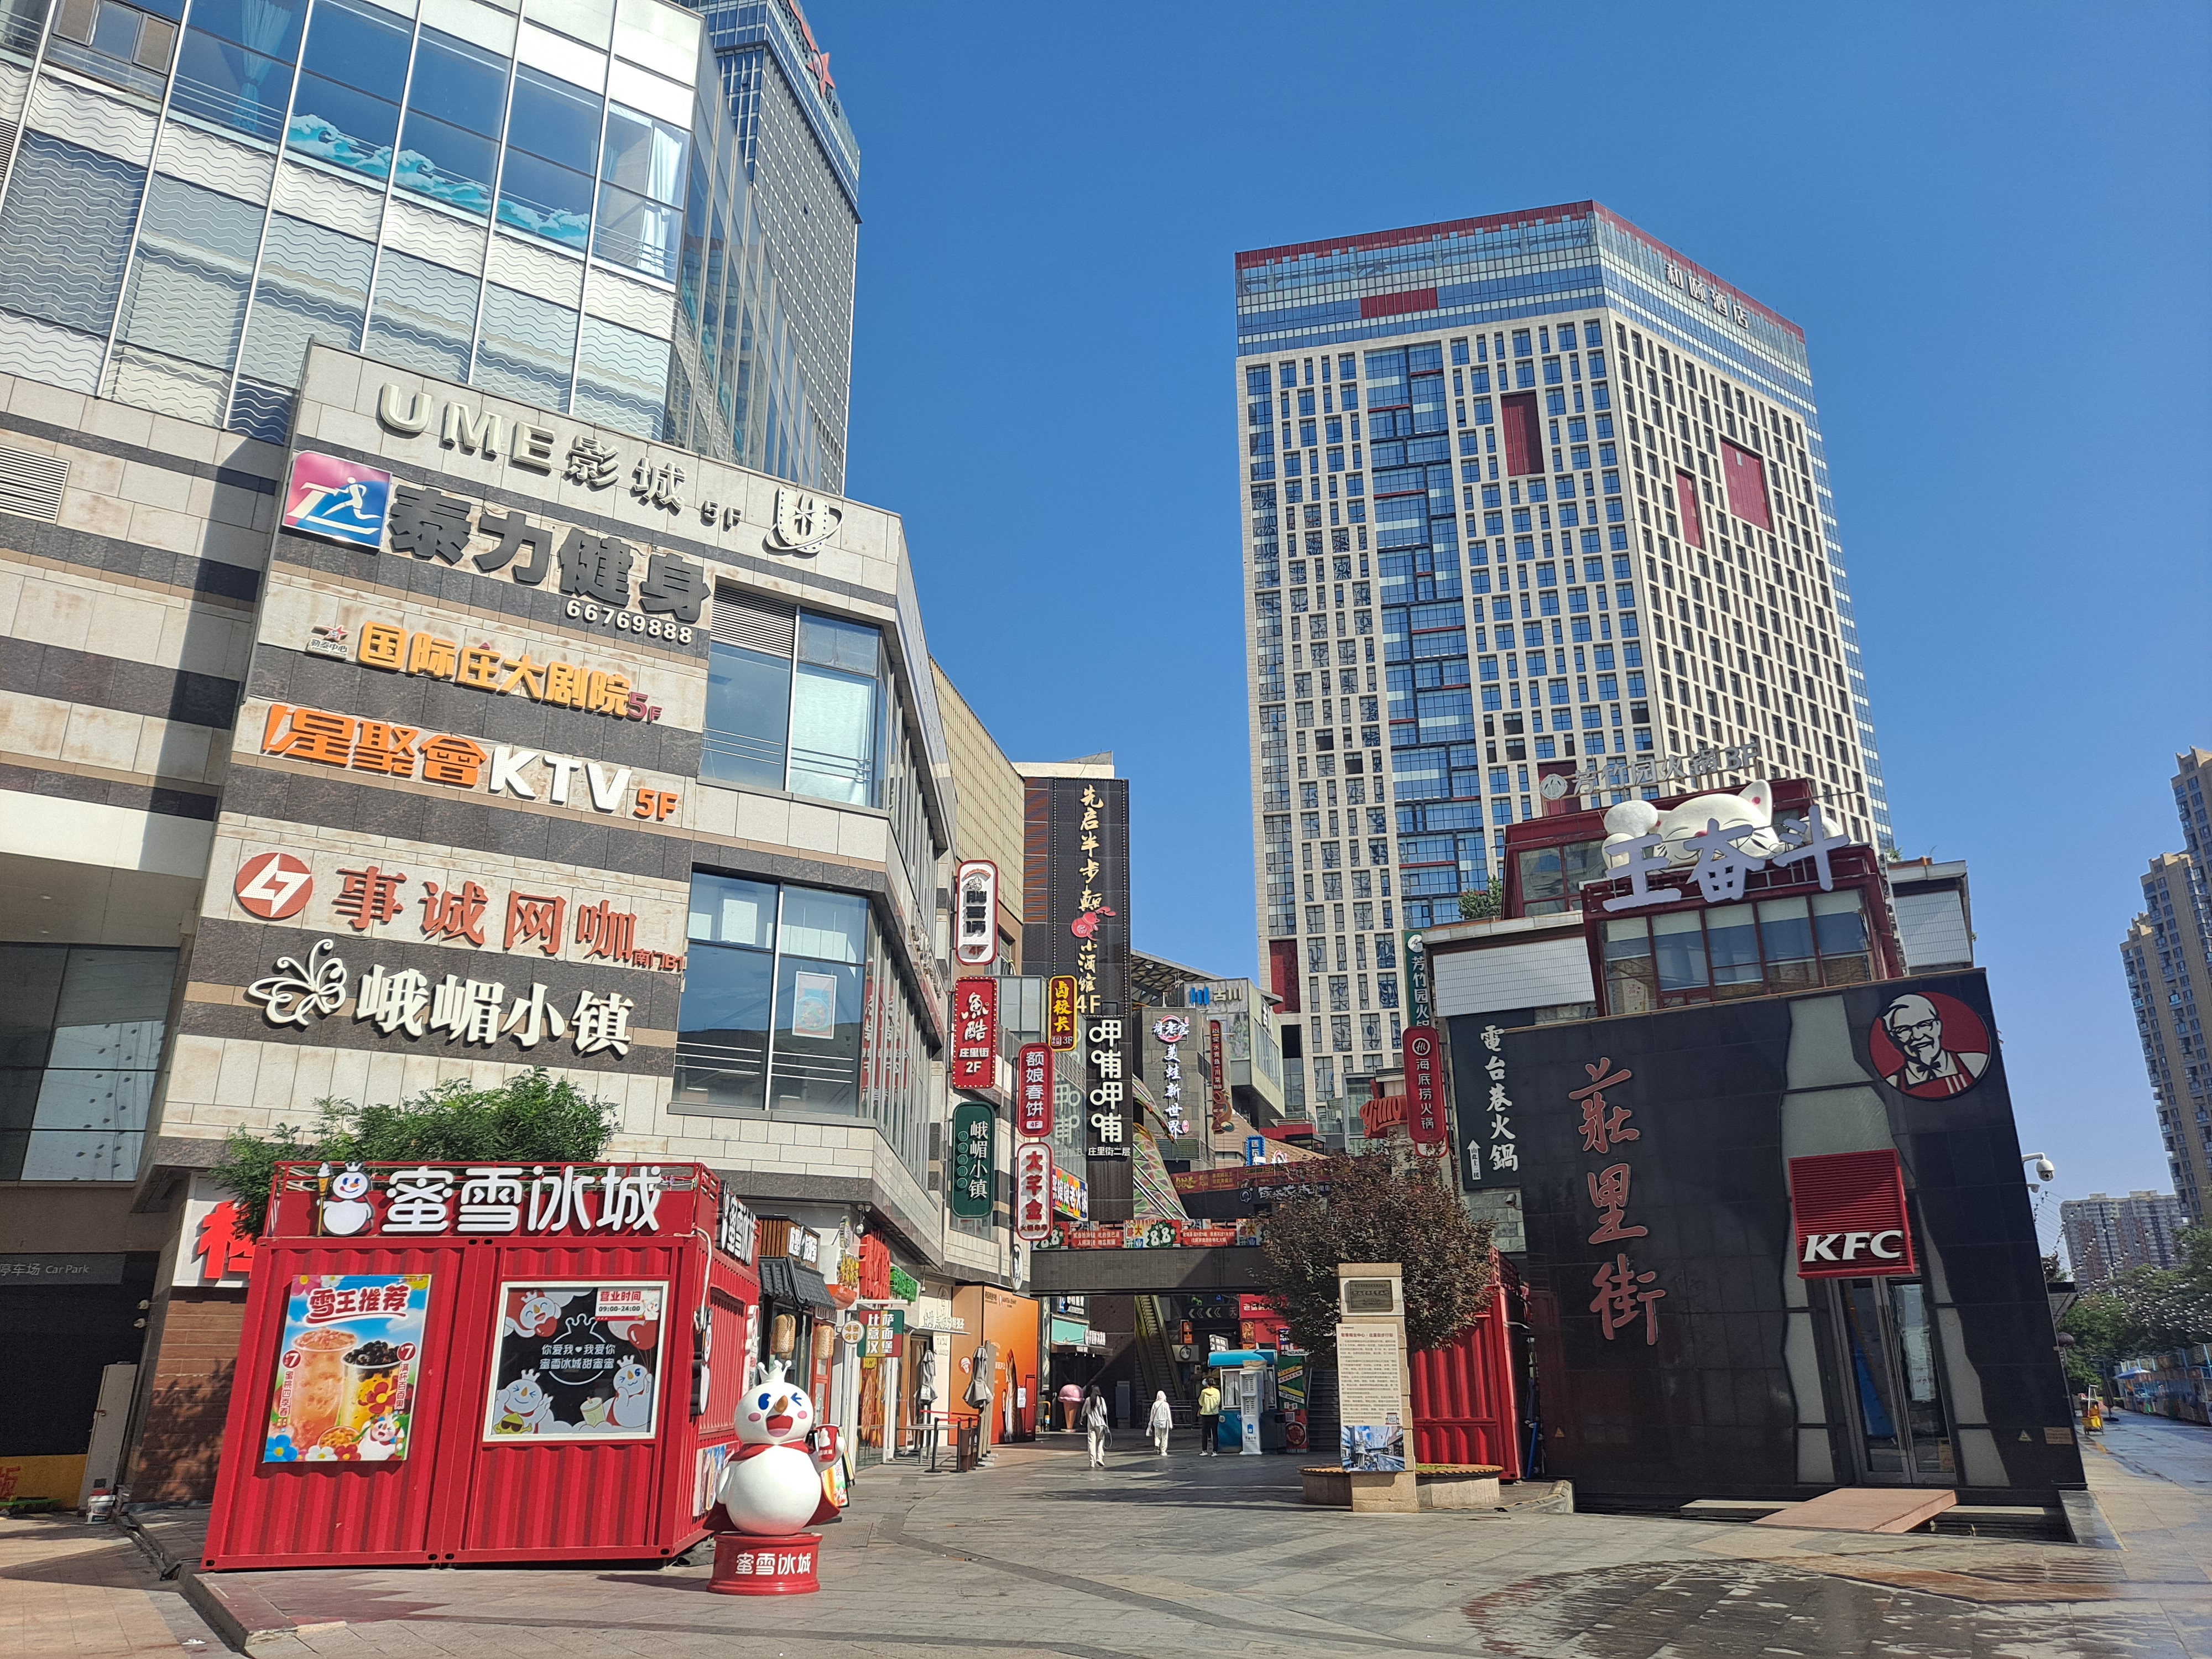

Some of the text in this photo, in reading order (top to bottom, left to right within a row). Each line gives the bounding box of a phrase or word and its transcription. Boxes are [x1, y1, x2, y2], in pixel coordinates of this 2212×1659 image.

[1666, 264, 1748, 329] 和颐酒店
[701, 499, 743, 529] 5F
[390, 484, 711, 623] 泰力健身
[566, 598, 692, 644] 66769888
[359, 621, 662, 722] 国际庄大剧院 5F
[634, 788, 678, 820] 5F
[1603, 806, 1850, 913] 王奋斗
[331, 865, 639, 959] 事诚网咖
[1078, 942, 1098, 992] 小酒馆
[356, 963, 634, 1056] 峨嵋小镇
[1053, 981, 1073, 1033] 卤校长
[1213, 987, 1242, 1001] 古川
[959, 1047, 989, 1058] 庄里街
[1063, 1036, 1073, 1044] 3F
[966, 1061, 982, 1073] 2F
[1025, 1051, 1045, 1116] 额娘春饼
[1089, 1019, 1123, 1142] 呷哺呷哺
[1163, 1044, 1183, 1139] 美蛙新世界
[1416, 1058, 1434, 1130] 海底捞火锅
[968, 1121, 988, 1198] 峨嵋小镇
[1088, 1147, 1131, 1156] 庄里街二层
[382, 1165, 662, 1233] 蜜雪冰城
[1801, 1229, 1904, 1263] KFC
[45, 1265, 64, 1274] Car
[65, 1265, 89, 1274] Park
[310, 1285, 409, 1318] 雪王推荐
[600, 1291, 641, 1301] 营业时间
[868, 1314, 894, 1326] 比萨
[395, 1364, 410, 1409] 满杯百香果
[539, 1358, 614, 1370] 蜜雪冰城甜蜜蜜
[280, 1371, 294, 1416] 蜜桃四季春
[735, 1553, 811, 1575] 蜜雪冰城
